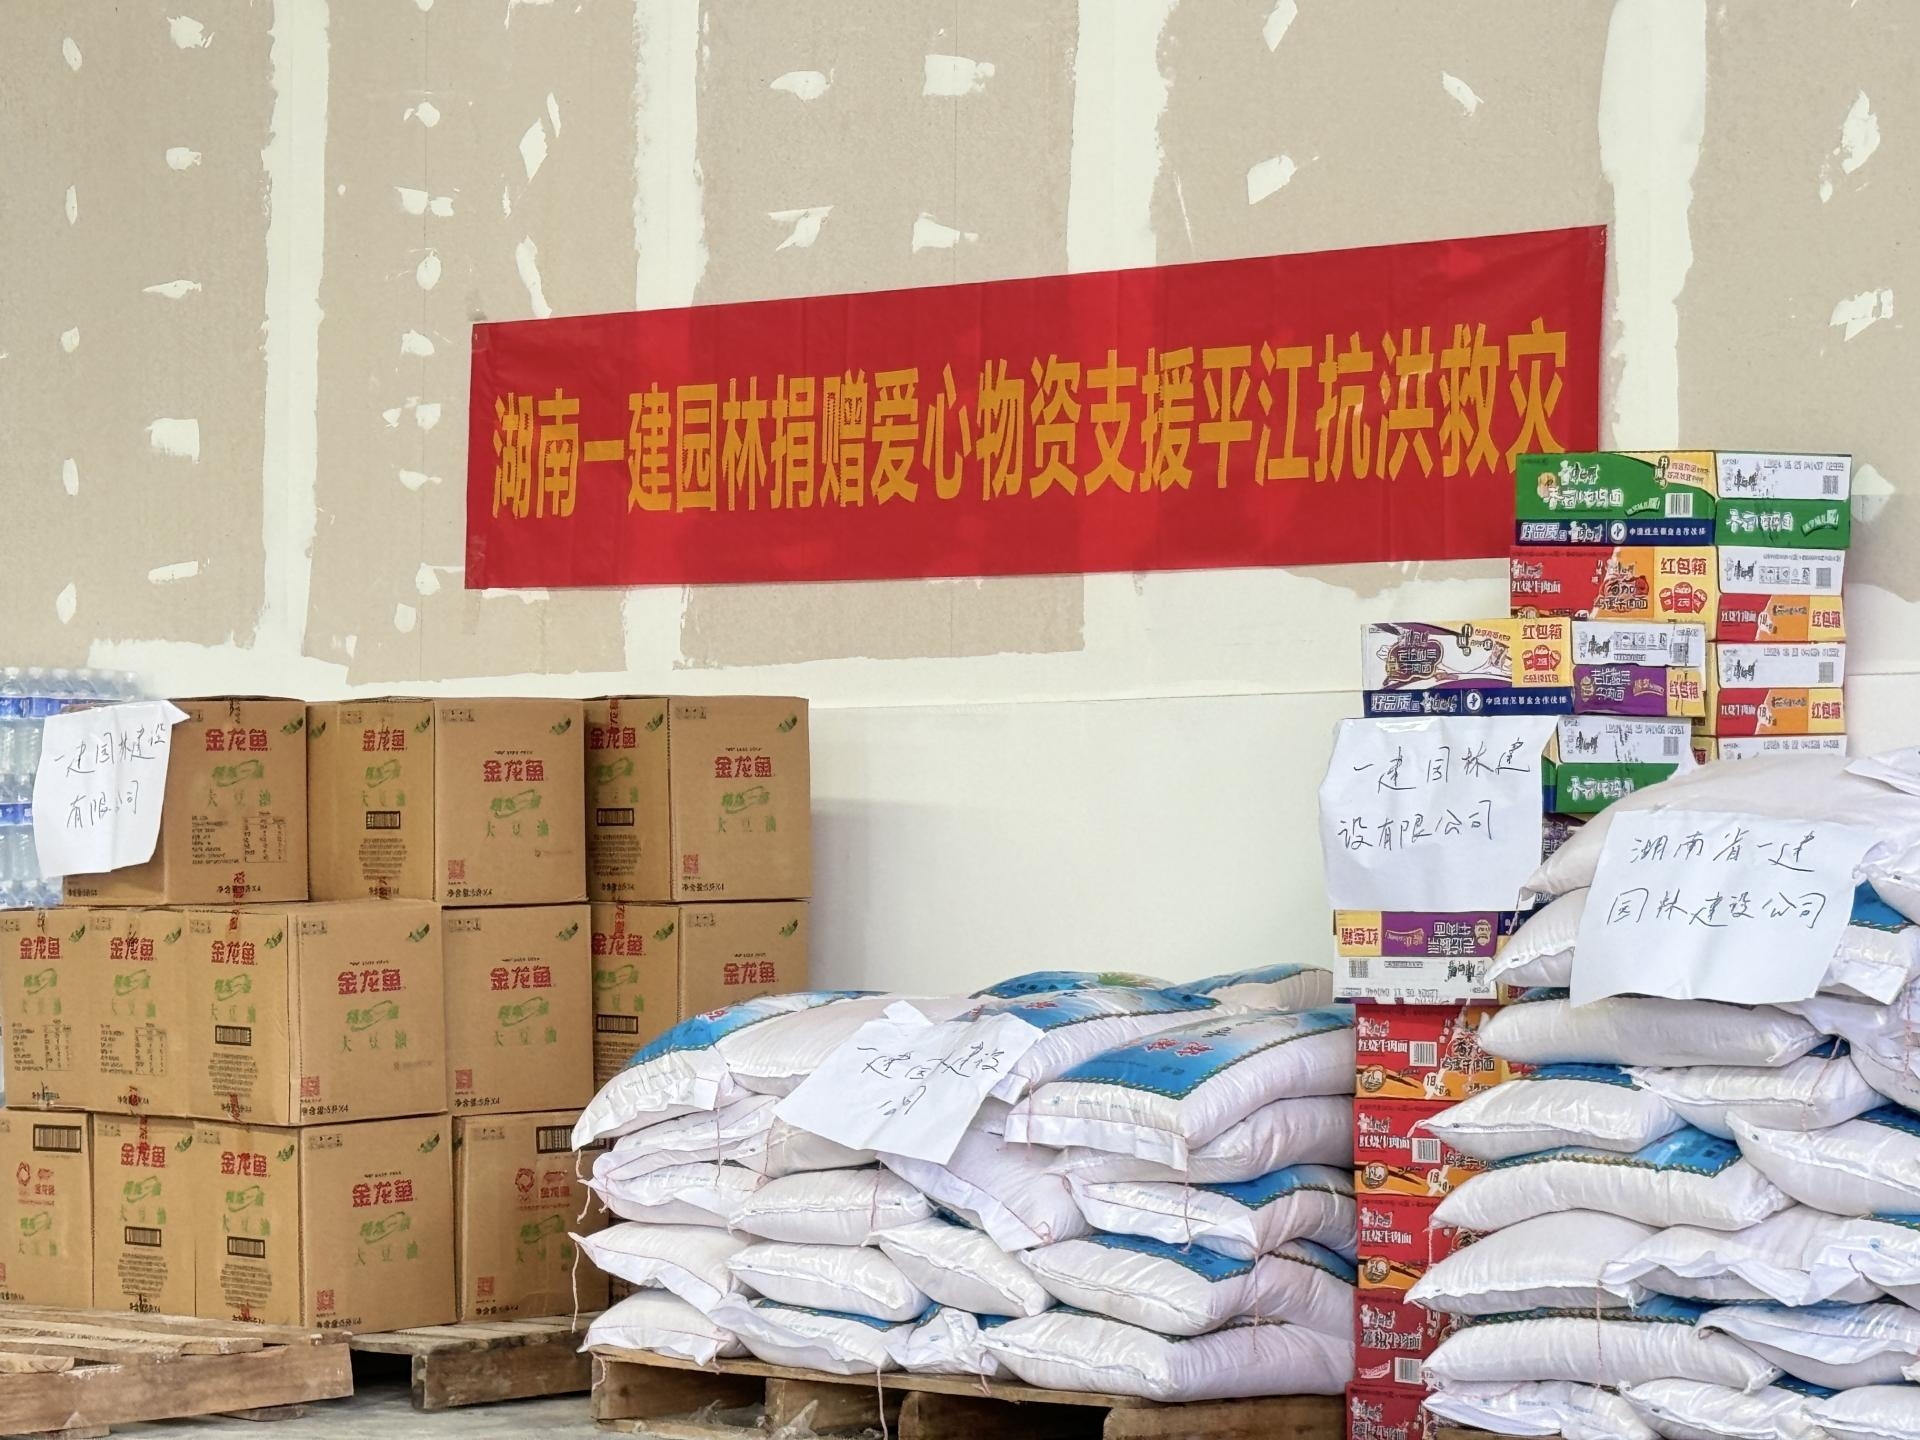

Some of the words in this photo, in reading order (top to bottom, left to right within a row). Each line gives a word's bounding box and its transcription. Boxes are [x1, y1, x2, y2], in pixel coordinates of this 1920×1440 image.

[492, 316, 1568, 519] 湖南一建园林捐赠爱心物资支援平江抗洪救灾
[1661, 557, 1707, 576] 红包箱
[1522, 624, 1562, 640] 红包箱
[205, 728, 271, 752] 金龙鱼
[589, 726, 637, 750] 金龙鱼
[483, 759, 546, 783] 金龙鱼
[714, 755, 774, 779] 金龙鱼
[1337, 799, 1493, 851] 设有限公司
[1630, 827, 1816, 873] 湖南省一建
[1606, 886, 1827, 929] 园林建设公司
[20, 936, 62, 960] 金龙鱼
[211, 940, 257, 966] 金龙鱼
[337, 968, 404, 995] 金龙鱼
[490, 965, 554, 991] 金龙鱼
[723, 960, 777, 986] 金龙鱼
[120, 1142, 166, 1169] 金龙鱼
[220, 1151, 269, 1178] 金龙鱼
[352, 1178, 415, 1208] 金龙鱼
